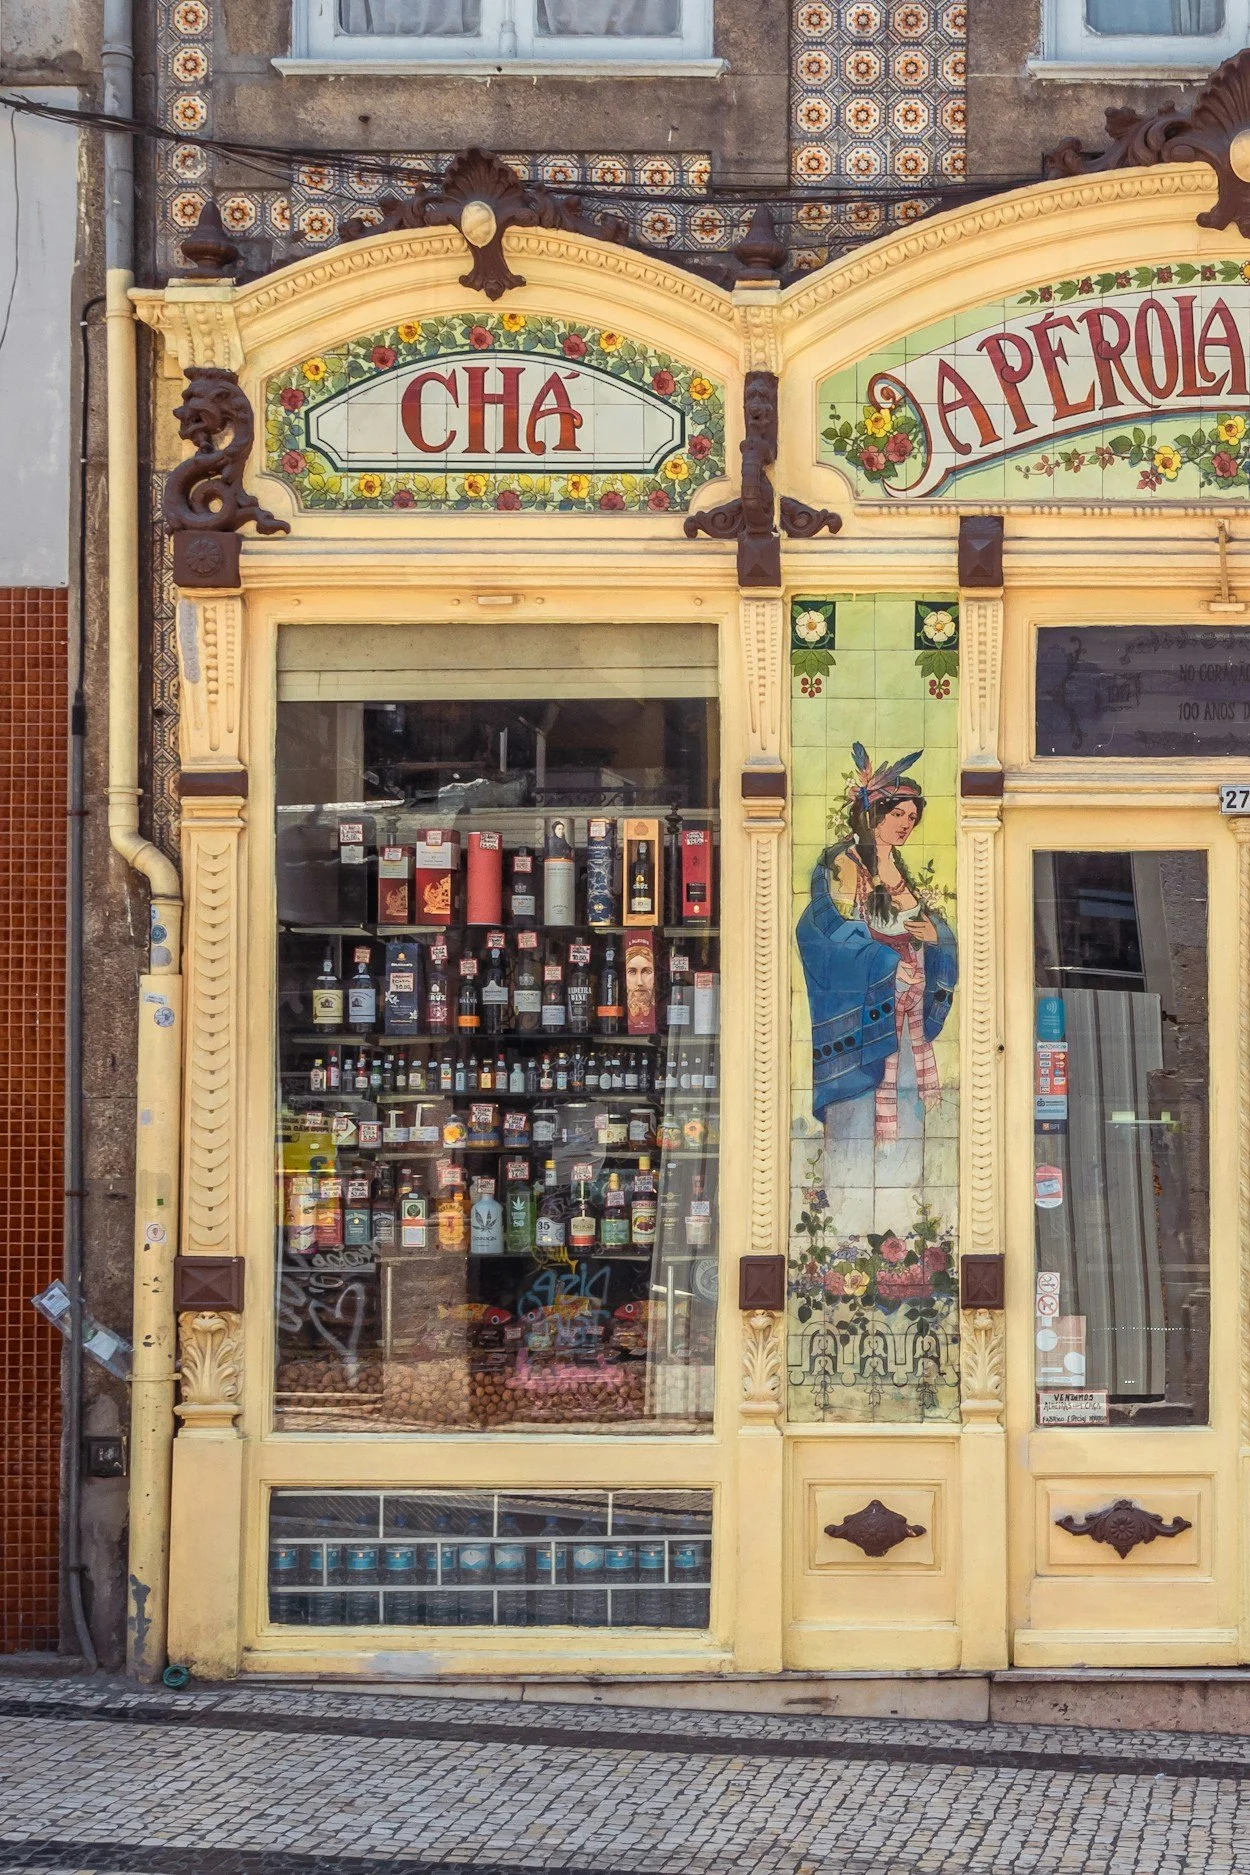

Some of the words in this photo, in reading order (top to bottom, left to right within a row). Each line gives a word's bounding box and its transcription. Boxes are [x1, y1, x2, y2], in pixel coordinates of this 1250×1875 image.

[400, 366, 583, 456] CHÁ
[931, 352, 1003, 455] A
[976, 294, 1250, 435] PÉROLA
[1178, 702, 1200, 721] 100
[1203, 702, 1236, 721] ANOS
